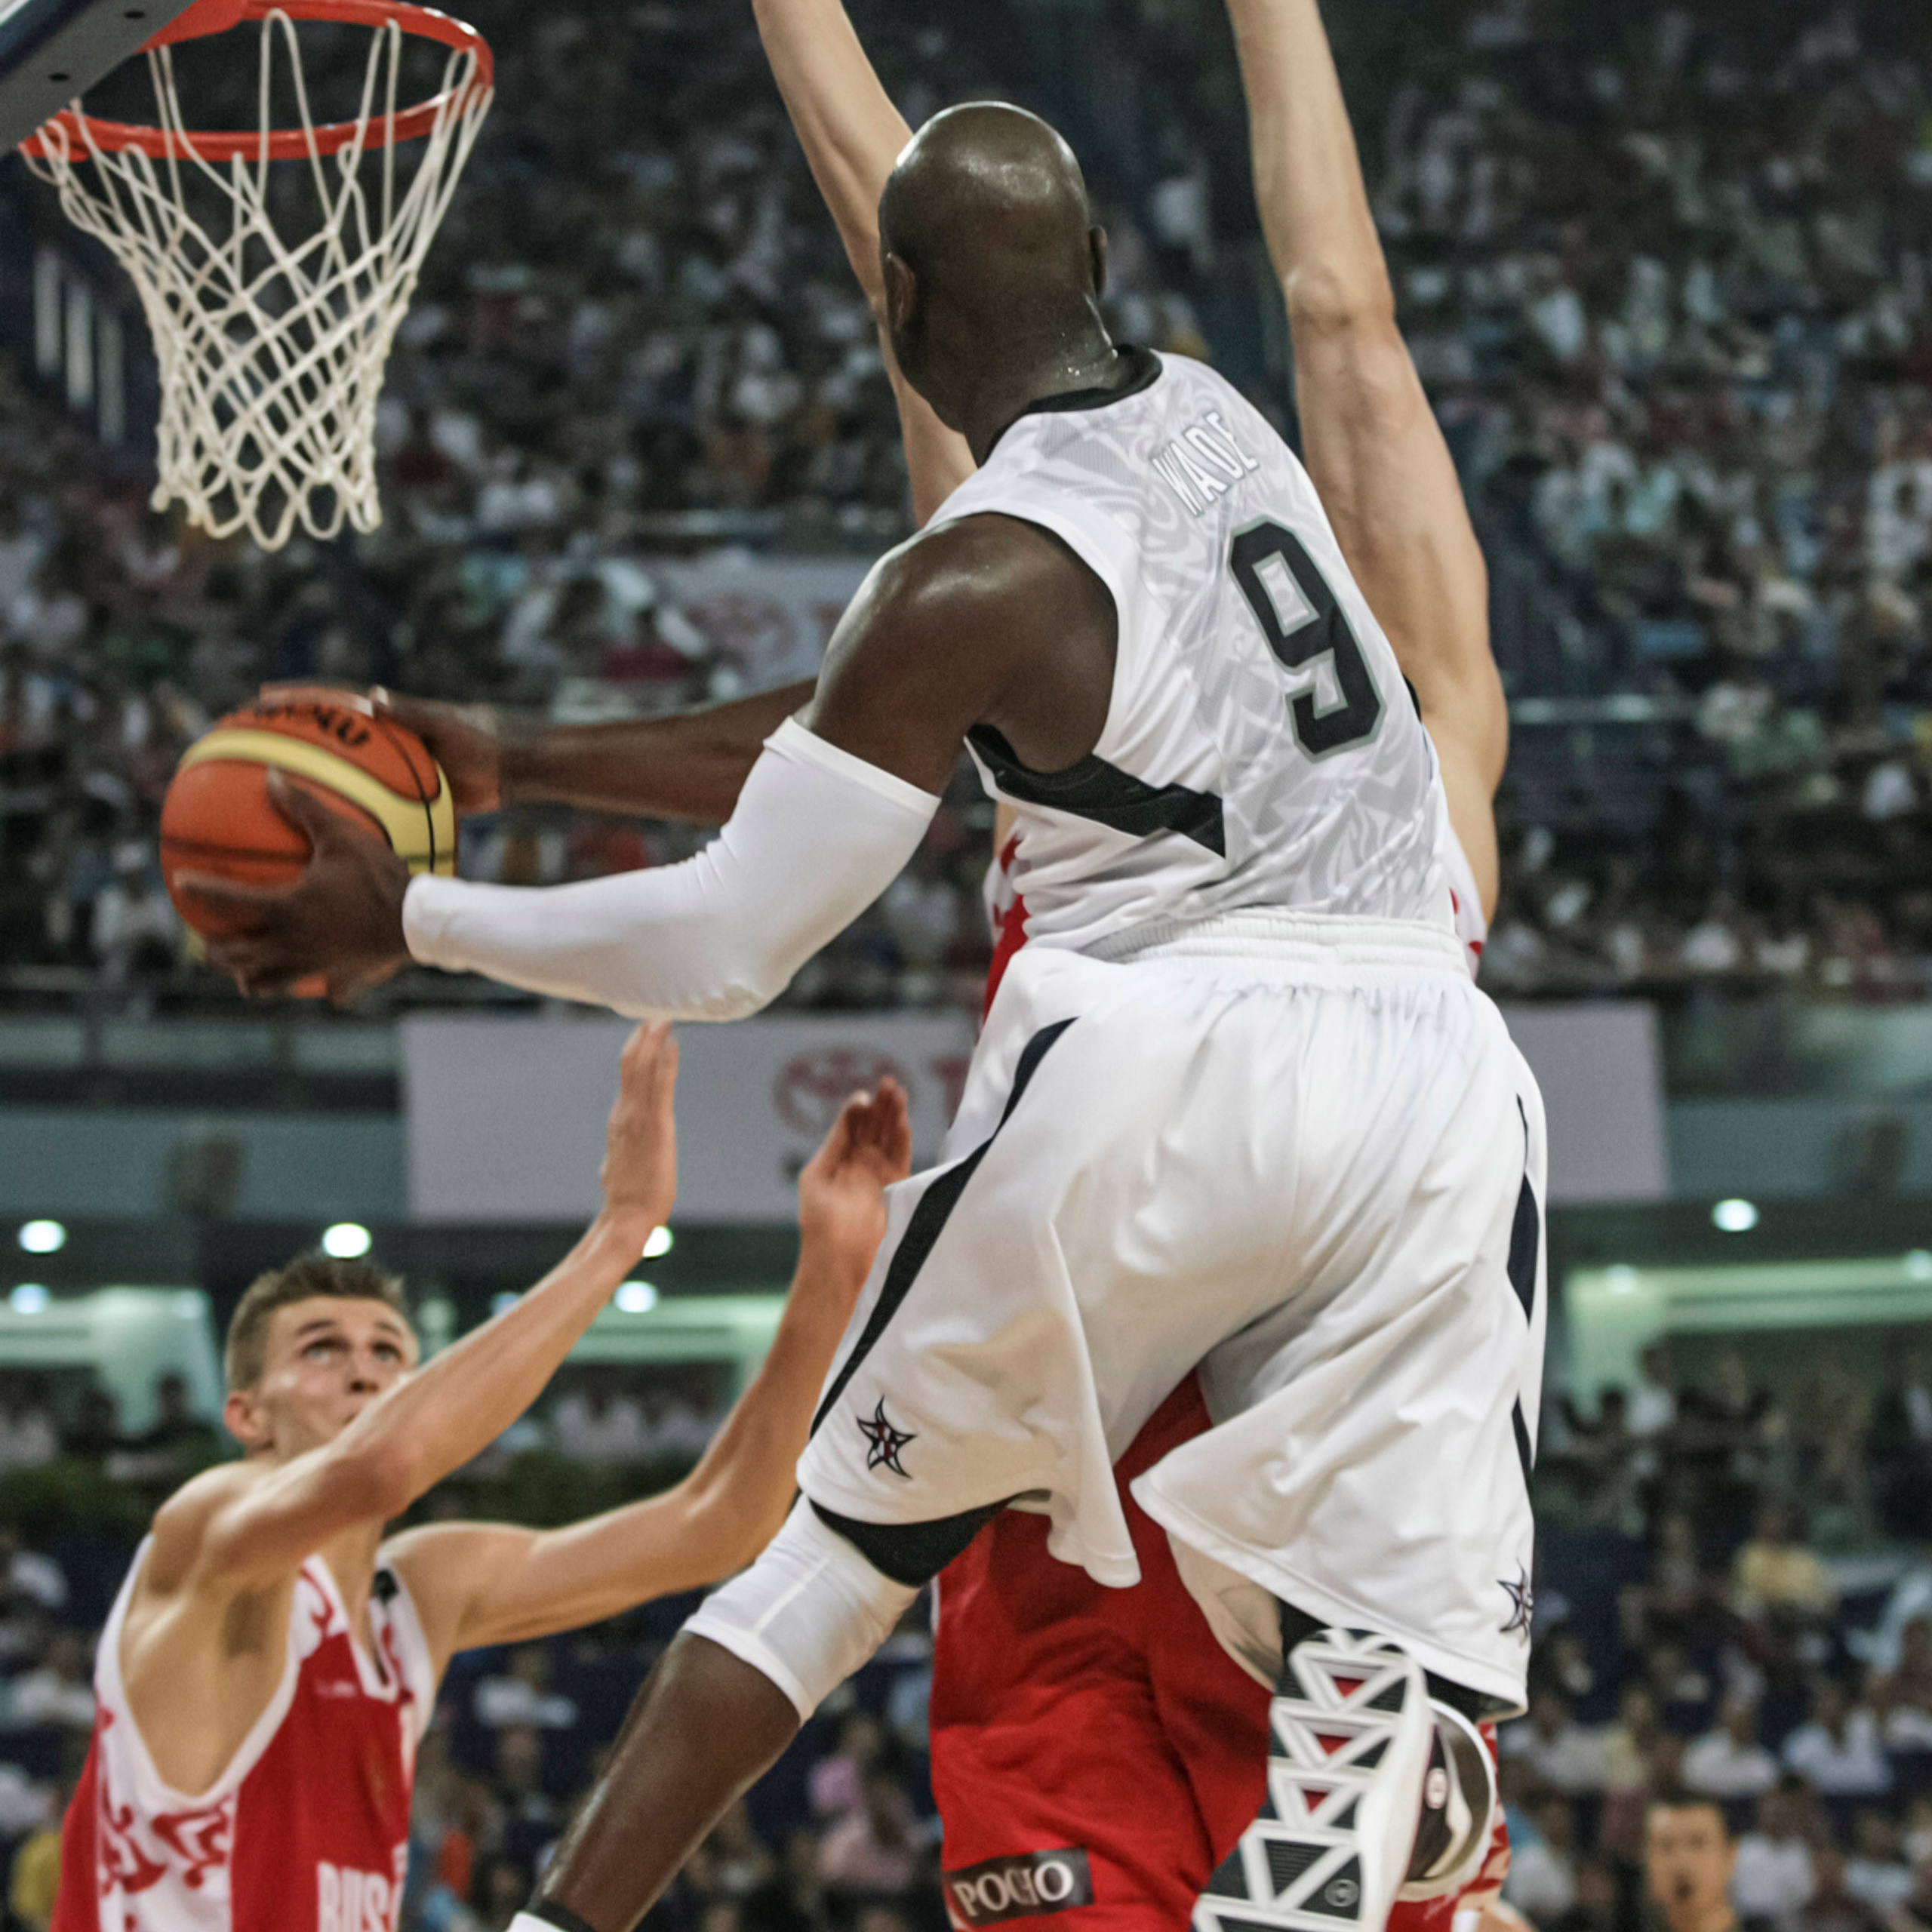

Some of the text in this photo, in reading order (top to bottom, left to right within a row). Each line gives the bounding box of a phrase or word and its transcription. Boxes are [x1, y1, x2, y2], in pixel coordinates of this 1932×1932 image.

[1152, 410, 1260, 518] WADE
[1226, 514, 1388, 764] 9
[315, 1861, 405, 1932] RUS
